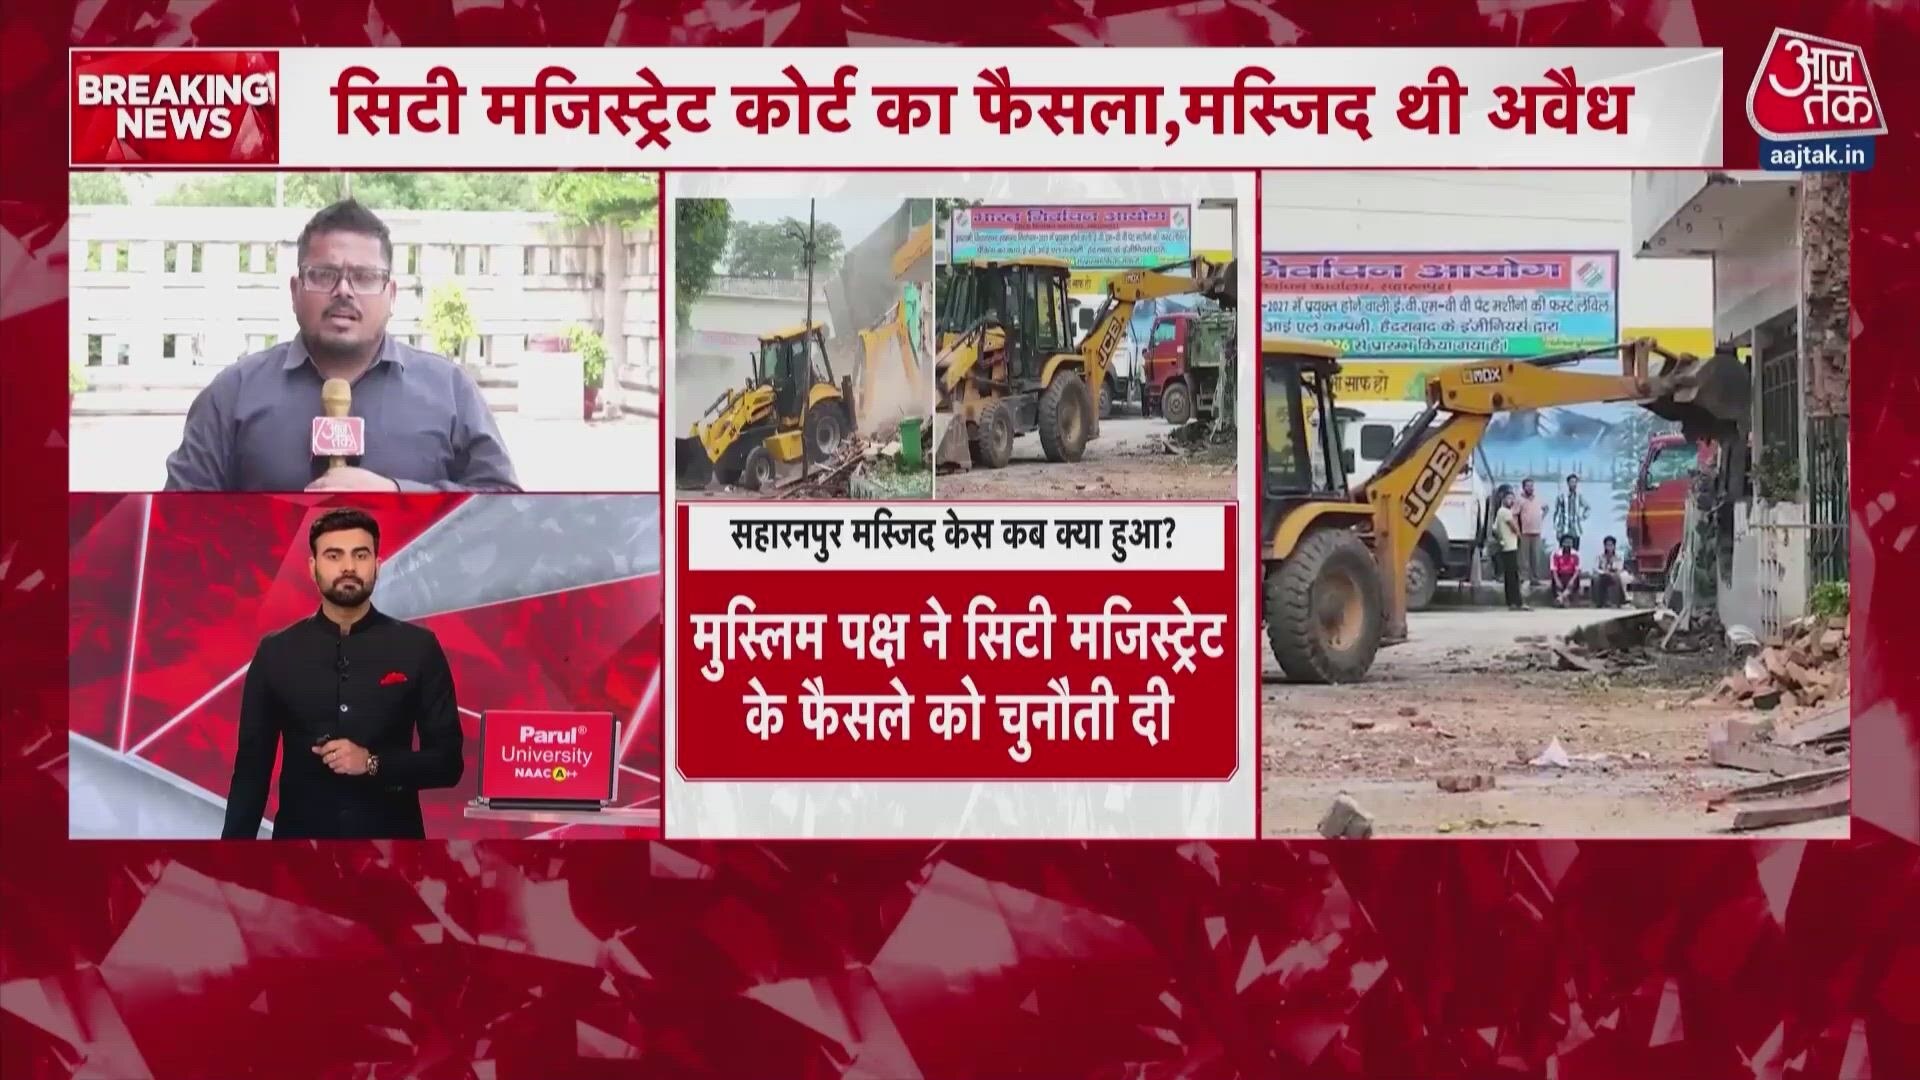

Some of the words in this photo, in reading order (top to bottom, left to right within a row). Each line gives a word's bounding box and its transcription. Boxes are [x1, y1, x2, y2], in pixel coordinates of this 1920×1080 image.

[1418, 256, 1562, 280] आयोग
[1398, 440, 1459, 526] JCB
[502, 746, 593, 768] University
[515, 768, 552, 778] NAAC
